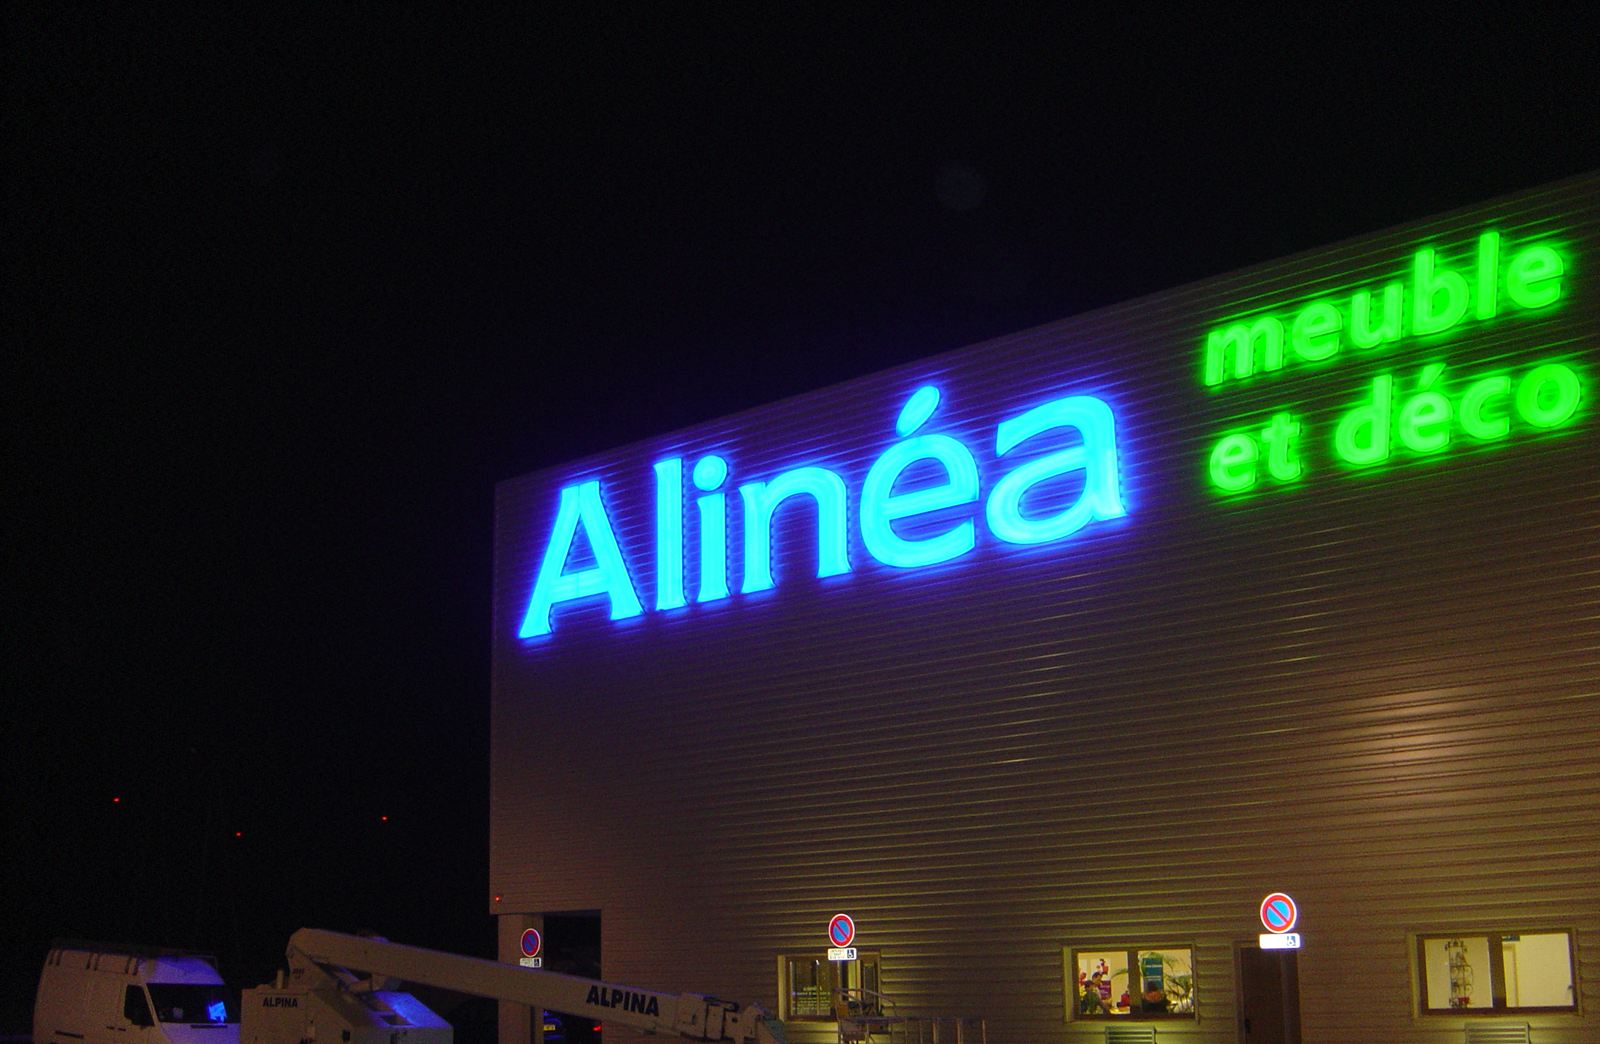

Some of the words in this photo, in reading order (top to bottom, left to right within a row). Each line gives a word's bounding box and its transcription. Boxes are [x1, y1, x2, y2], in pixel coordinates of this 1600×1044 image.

[1205, 231, 1564, 387] meuble
[1209, 412, 1301, 492] et
[1335, 363, 1581, 465] déco
[518, 385, 1129, 639] Alinéa
[262, 996, 298, 1008] ALPINA
[586, 985, 660, 1017] ALPINA
